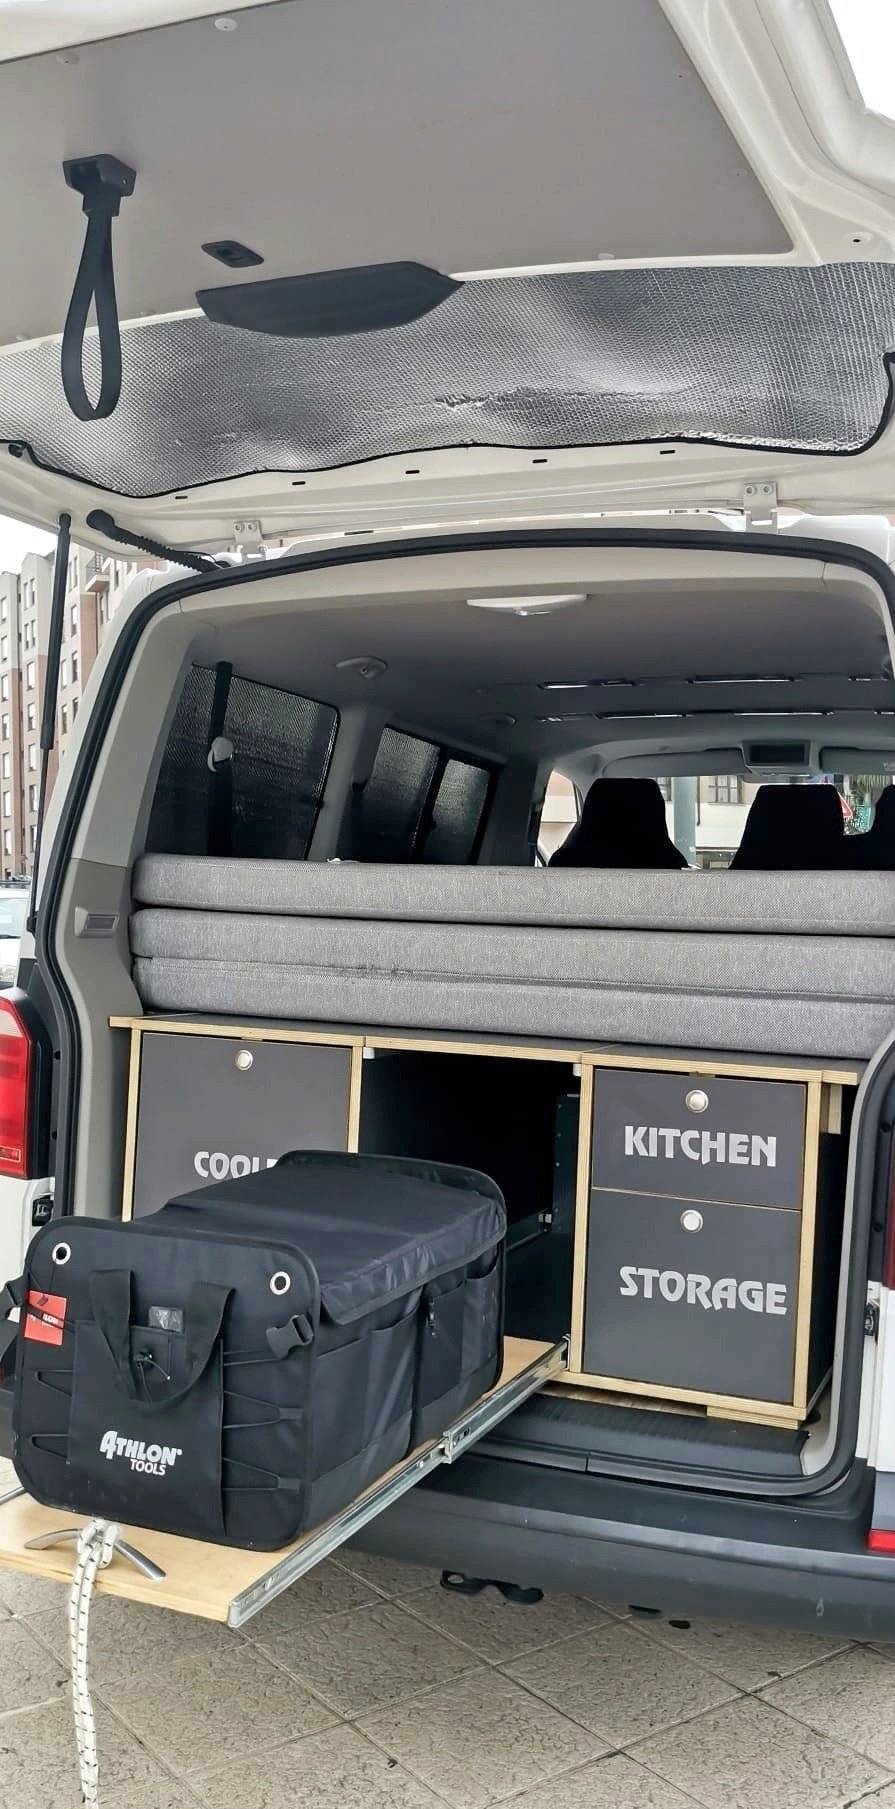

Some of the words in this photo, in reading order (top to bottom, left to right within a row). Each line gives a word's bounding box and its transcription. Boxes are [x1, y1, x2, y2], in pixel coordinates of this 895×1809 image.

[624, 1125, 777, 1167] KITCHEN
[194, 1151, 279, 1180] COOL
[619, 1265, 788, 1315] STORAGE
[130, 1458, 167, 1476] TOOLS
